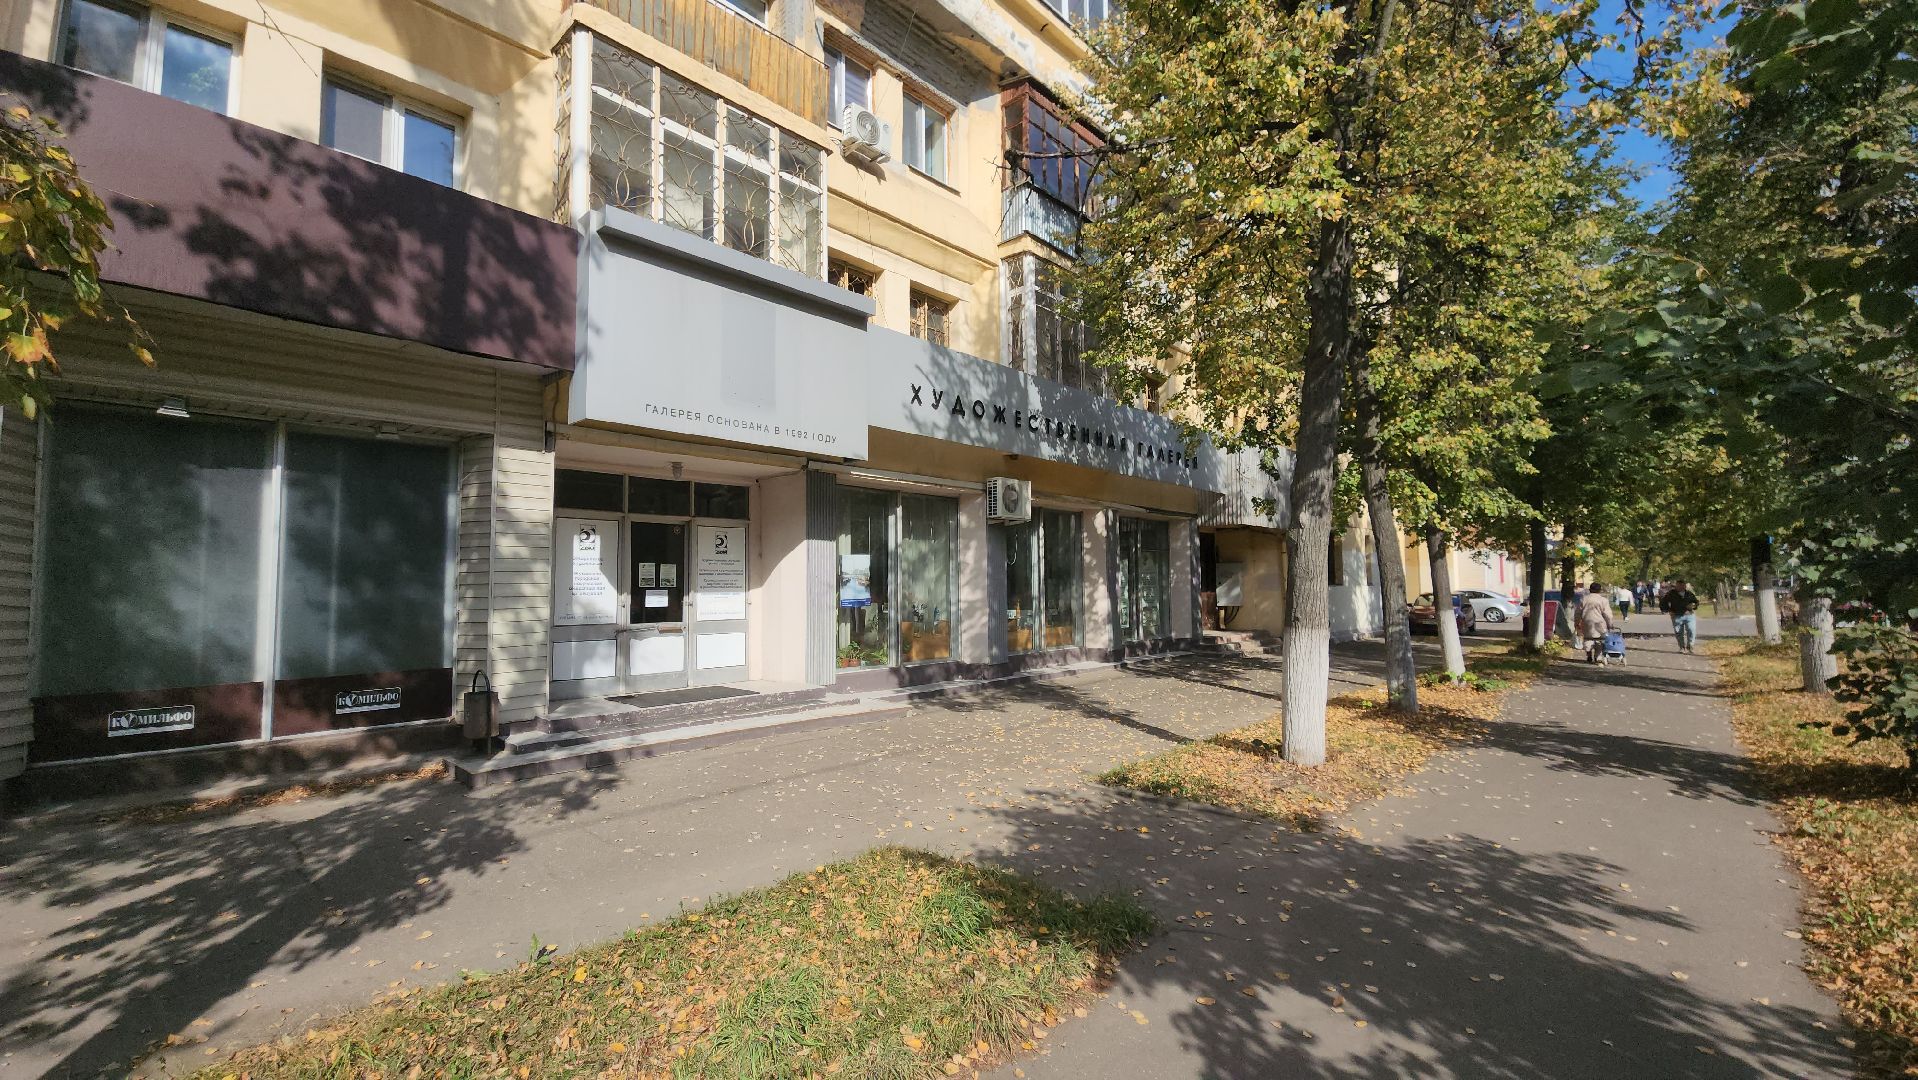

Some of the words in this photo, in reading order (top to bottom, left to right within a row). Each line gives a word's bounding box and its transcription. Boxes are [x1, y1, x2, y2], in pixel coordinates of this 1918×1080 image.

[645, 403, 701, 421] ГАЛЕРЕЯ
[707, 414, 769, 433] ОСНОВАНА
[774, 426, 780, 435] В
[910, 383, 1127, 451] ХУДОЖЕСТВЕННАЯ
[1137, 442, 1198, 469] ГАЛЕРЕЯ
[338, 692, 399, 707] КОМИЛЬФО
[112, 711, 192, 728] КОМИЛЬФО
